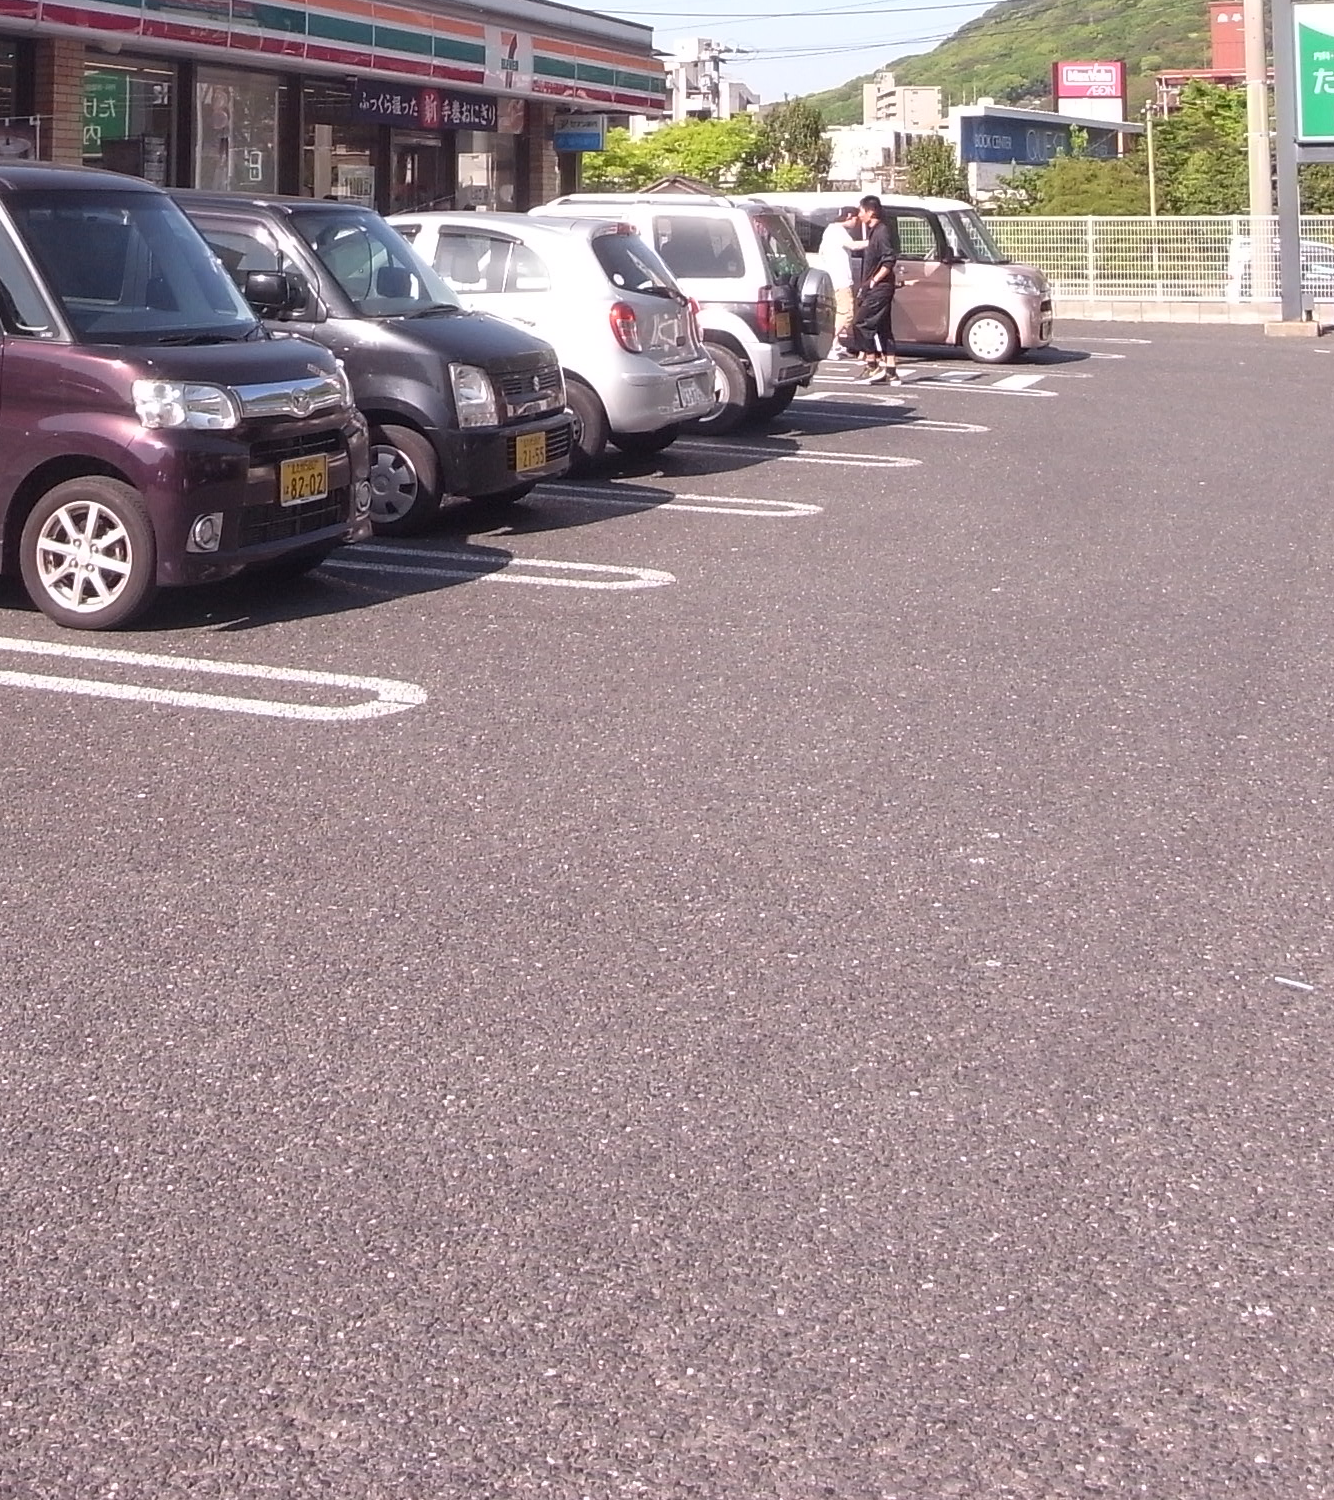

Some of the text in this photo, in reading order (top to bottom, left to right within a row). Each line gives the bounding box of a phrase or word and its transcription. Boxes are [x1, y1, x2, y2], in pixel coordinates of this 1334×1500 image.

[359, 92, 418, 117] ふっくら握った
[441, 100, 497, 127] 手巻おにぎり
[291, 472, 324, 499] 82-02
